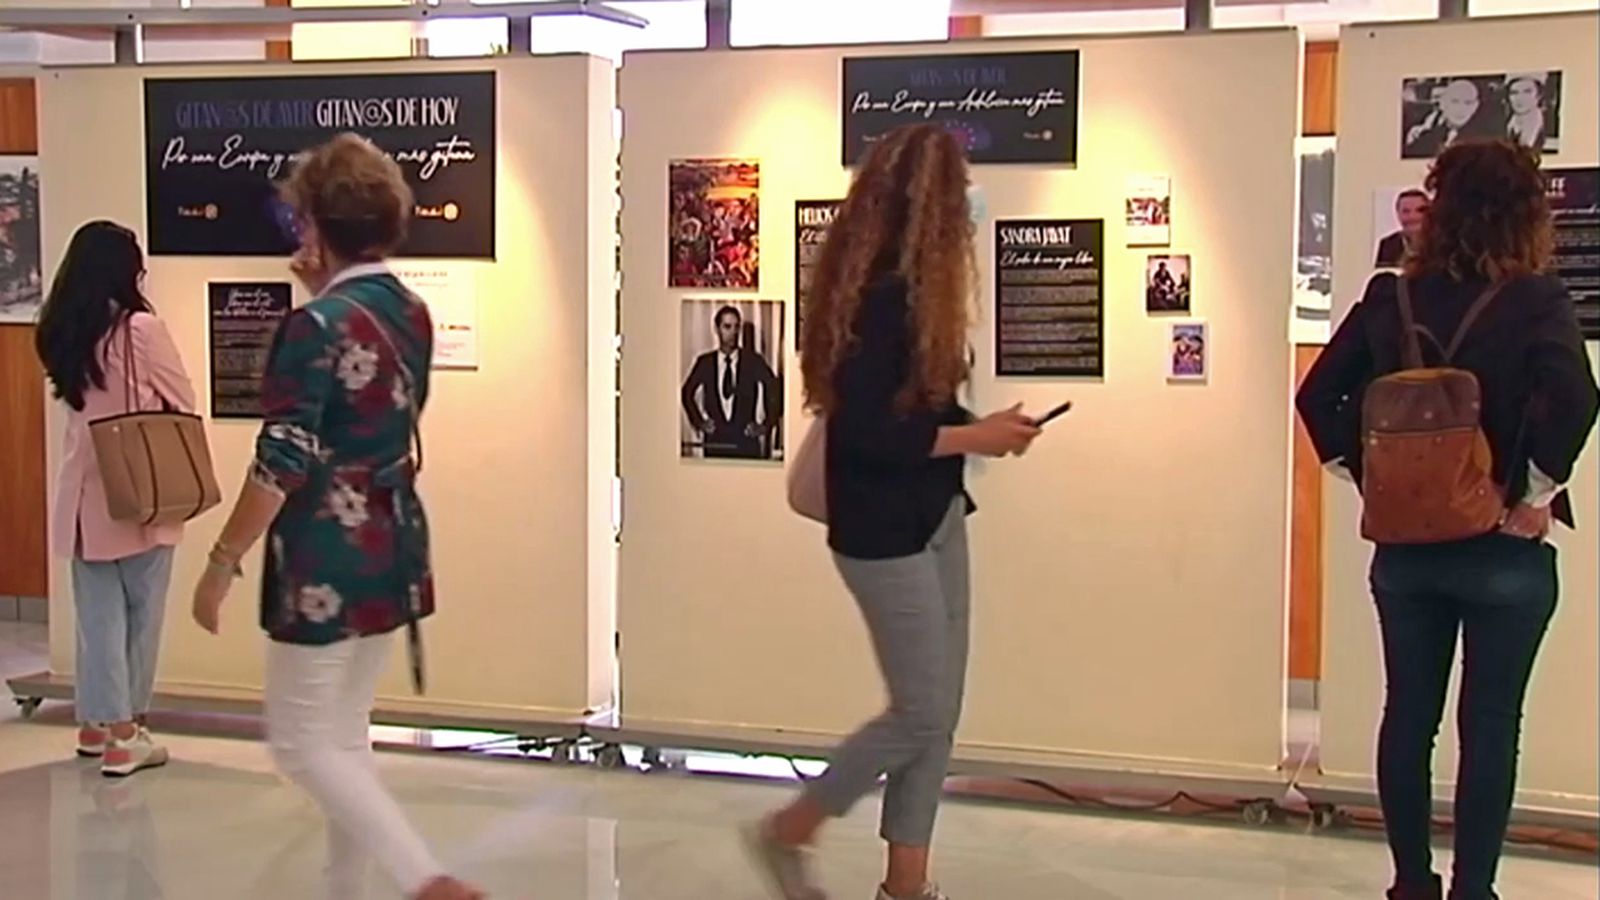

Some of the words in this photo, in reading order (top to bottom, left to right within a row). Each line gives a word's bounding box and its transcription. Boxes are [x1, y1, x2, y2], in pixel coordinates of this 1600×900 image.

[175, 101, 250, 128] GITAN@S
[252, 100, 272, 128] DE
[316, 99, 393, 128] GITAN@S
[396, 99, 419, 127] DE
[421, 97, 459, 126] HOY
[218, 134, 271, 170] Europa
[266, 153, 285, 179] y
[418, 134, 476, 180] gitana
